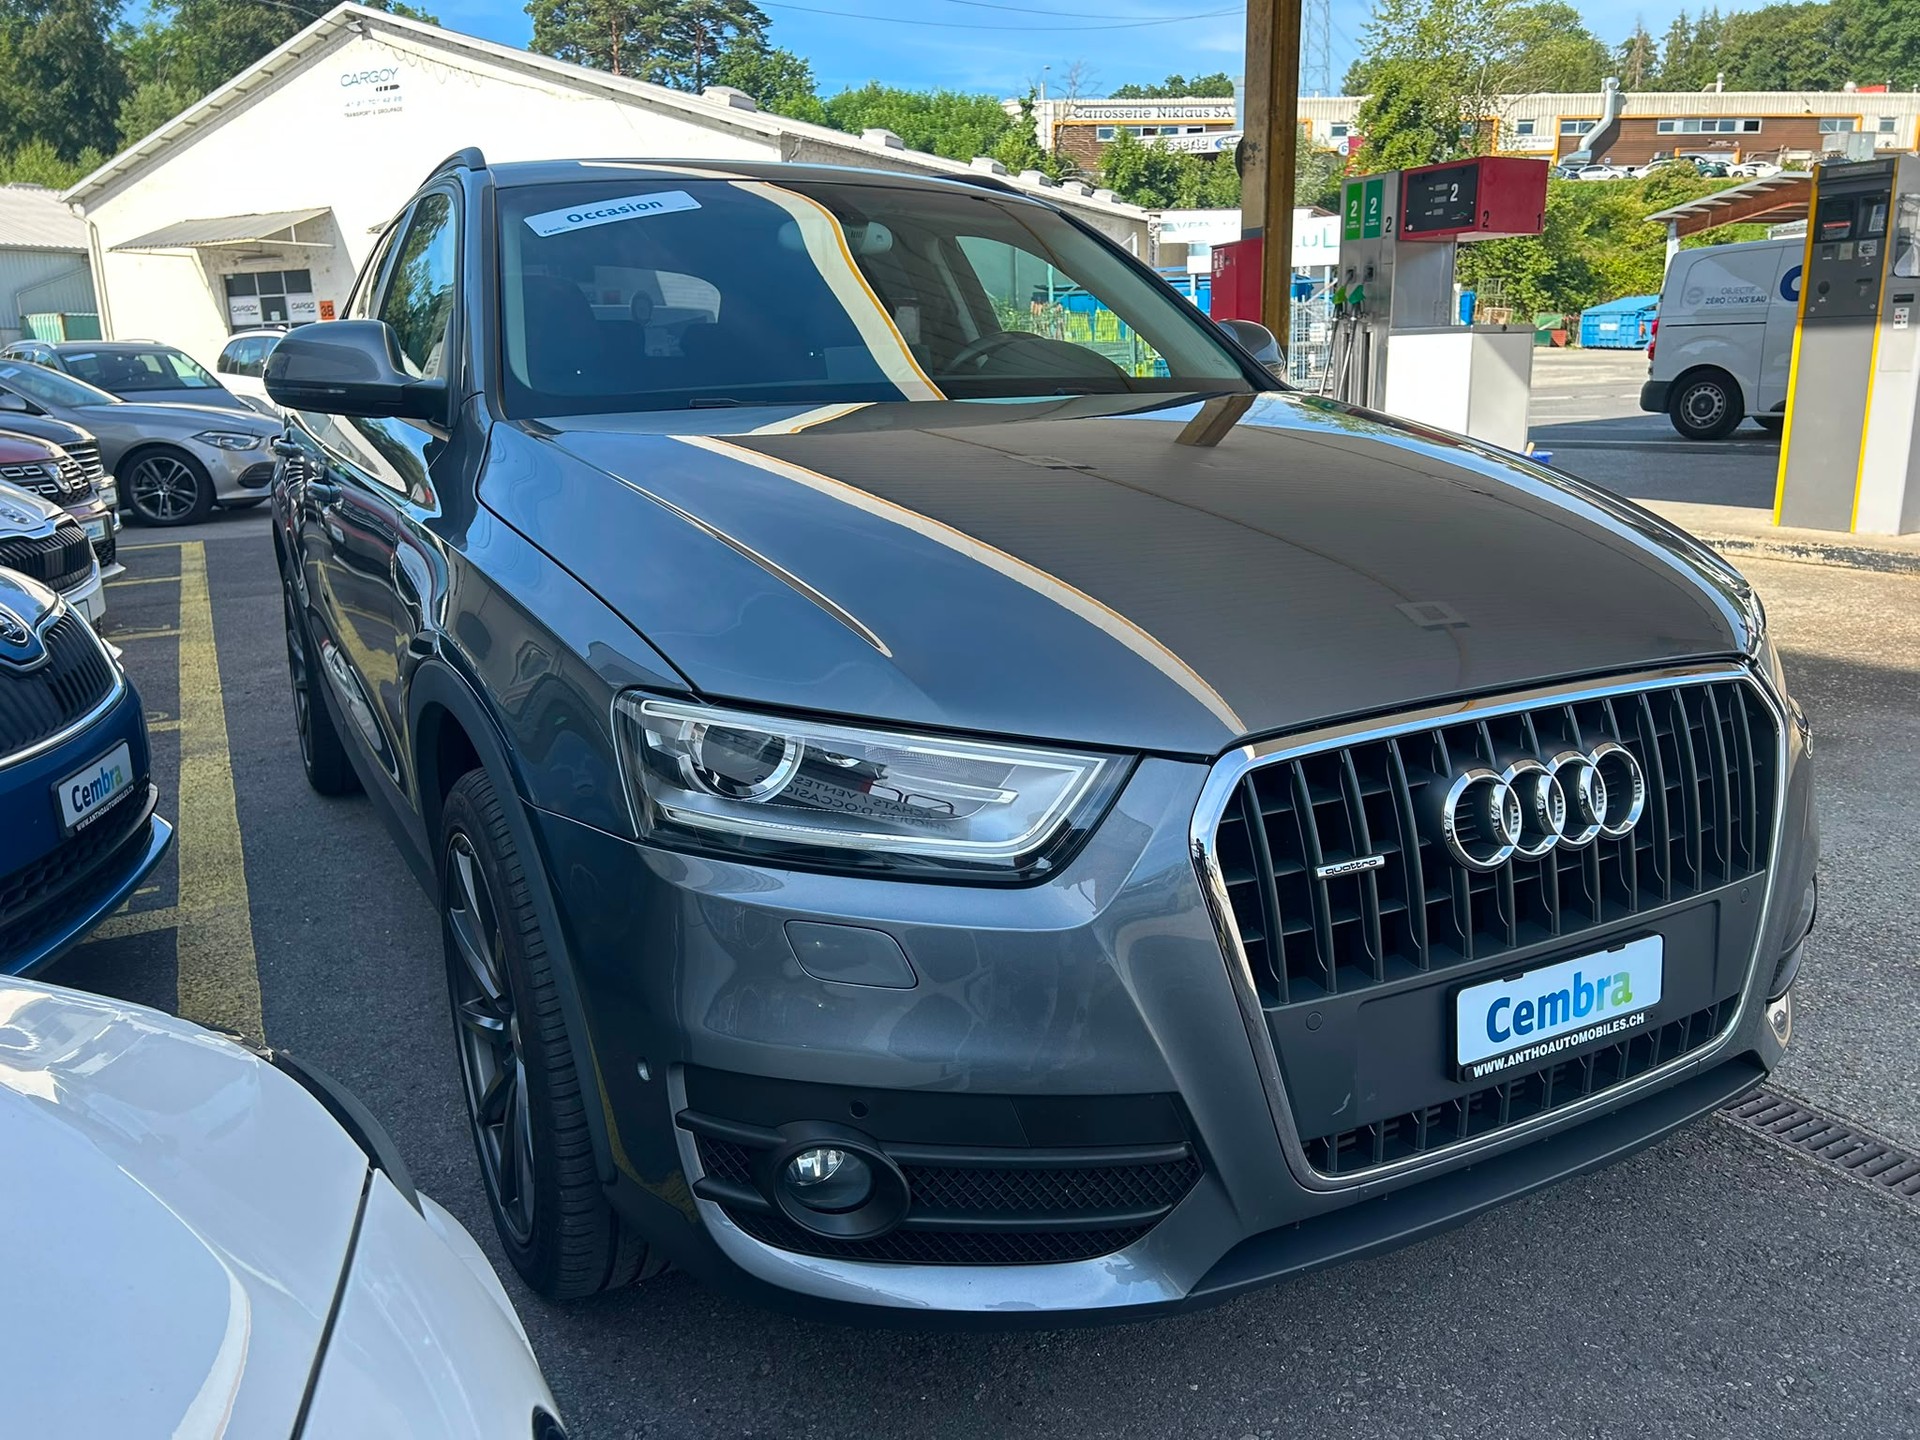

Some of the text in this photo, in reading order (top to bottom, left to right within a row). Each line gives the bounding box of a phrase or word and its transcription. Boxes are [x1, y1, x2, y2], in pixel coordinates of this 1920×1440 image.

[340, 67, 399, 87] CARGOY
[1074, 106, 1232, 119] Carrosserie Niklaus SA
[1450, 183, 1459, 202] 2
[566, 200, 663, 223] Occasion
[1350, 200, 1358, 217] 2
[1370, 197, 1378, 215] 2
[1385, 216, 1392, 233] 2
[1482, 210, 1542, 231] 2 1
[232, 304, 258, 312] CARGOY
[321, 305, 334, 317] 3B
[72, 765, 123, 813] Cembra
[1325, 860, 1377, 875] quattro
[1486, 971, 1633, 1044] Cembra
[1473, 1012, 1645, 1078] WWW.ANTHOAUTOMOBILES.CH
